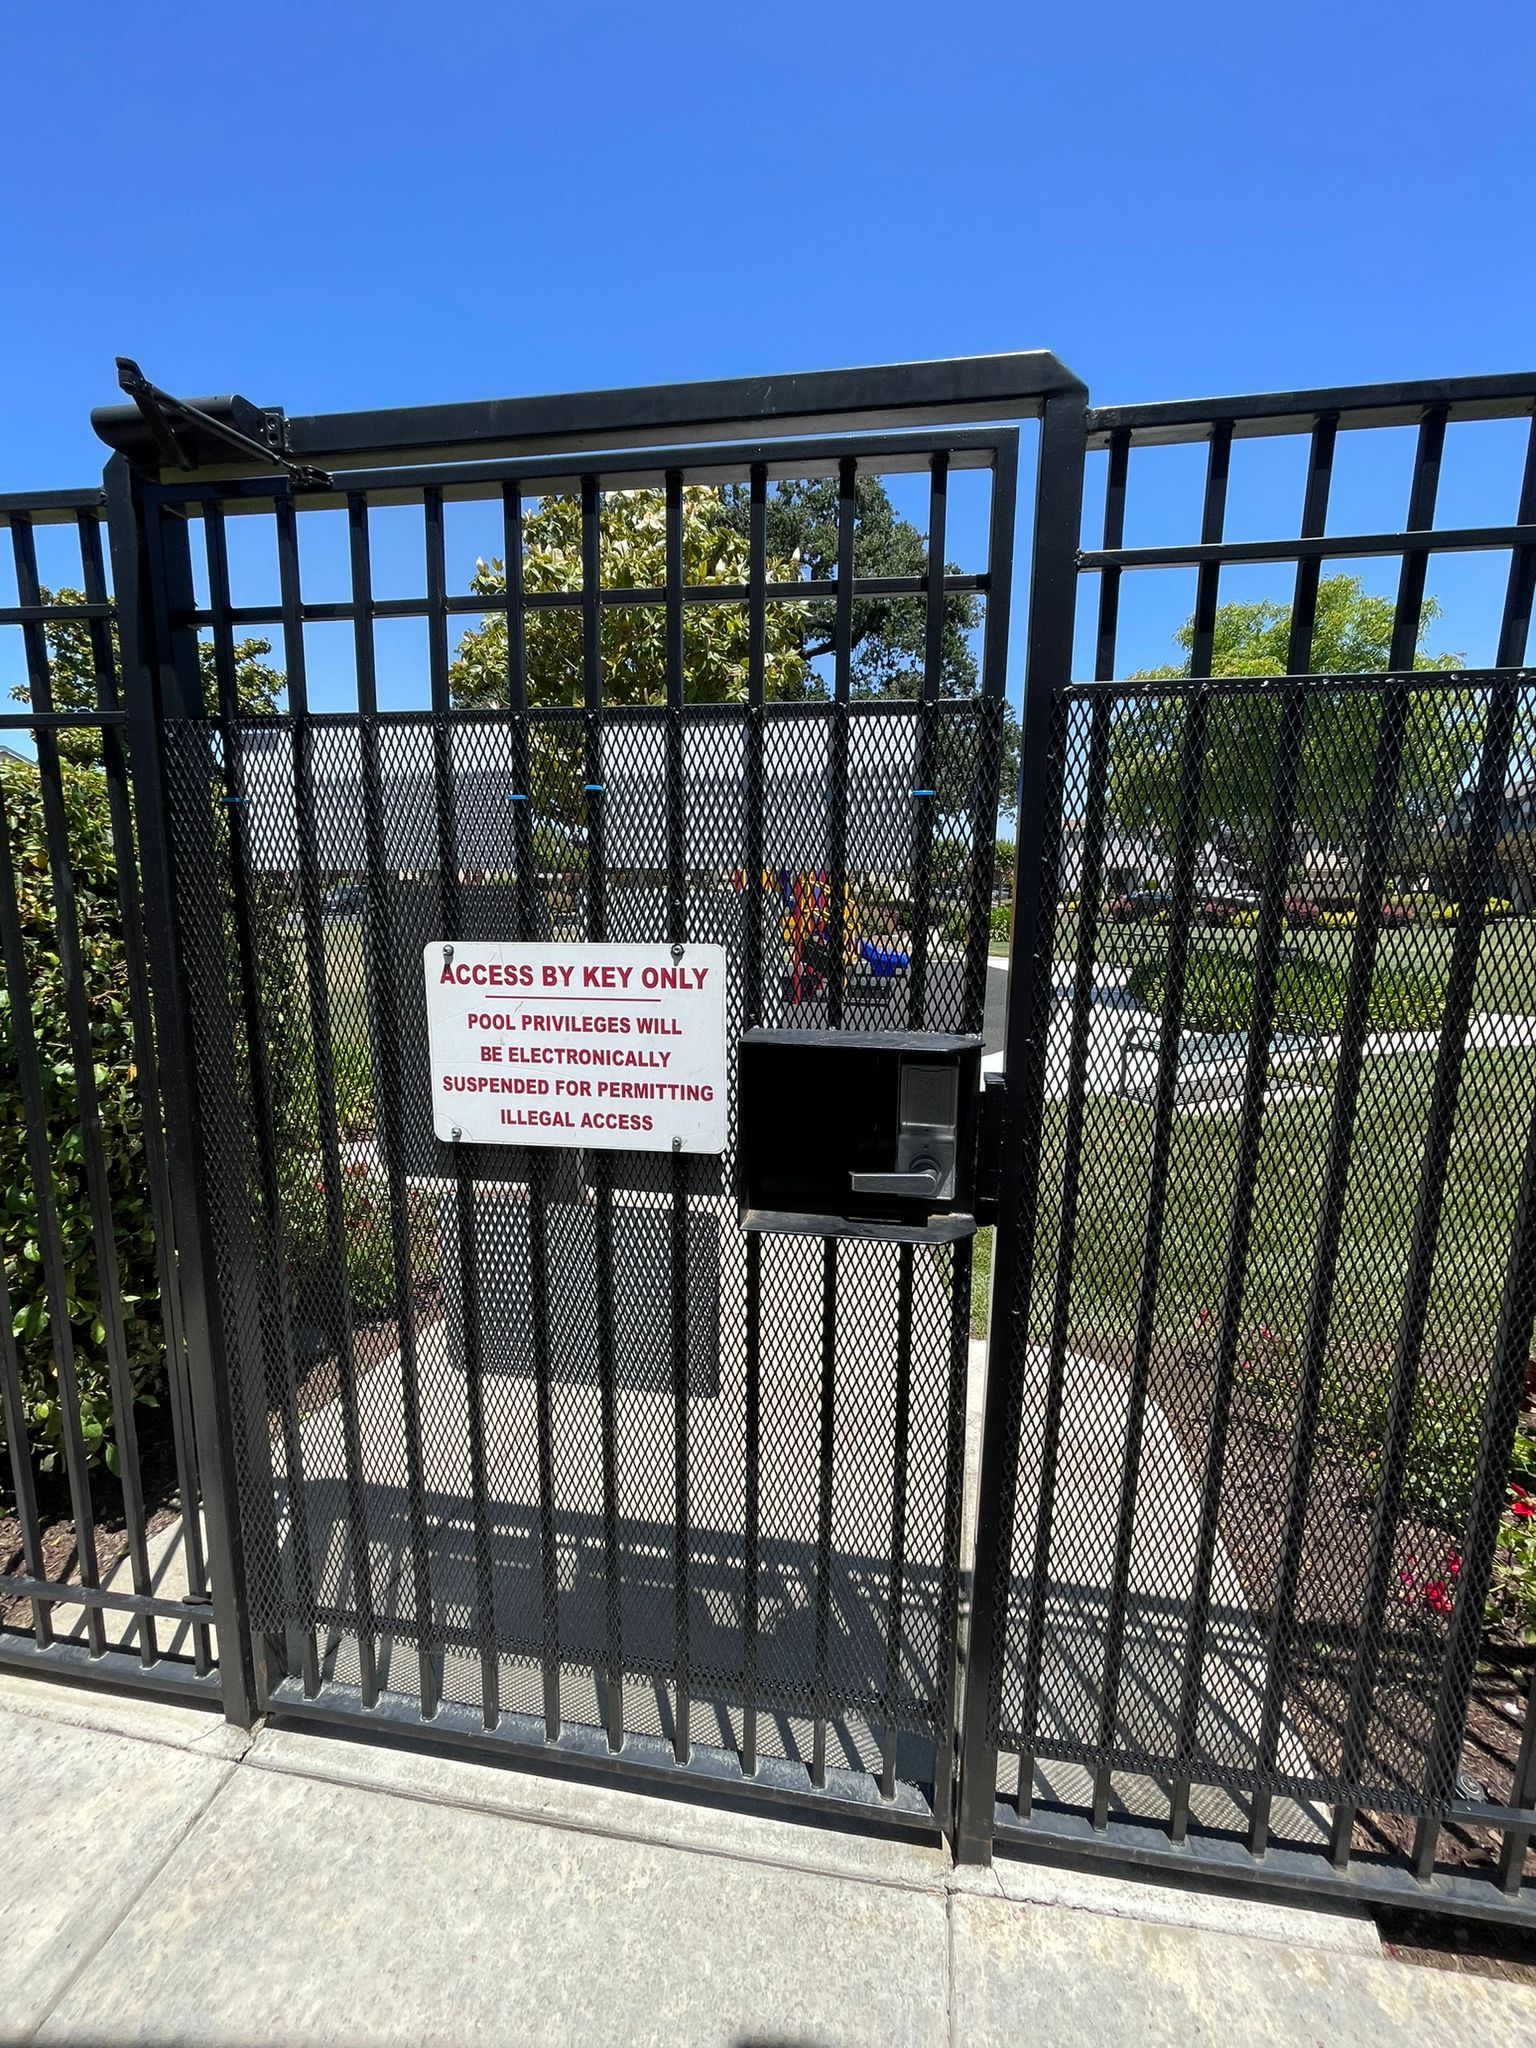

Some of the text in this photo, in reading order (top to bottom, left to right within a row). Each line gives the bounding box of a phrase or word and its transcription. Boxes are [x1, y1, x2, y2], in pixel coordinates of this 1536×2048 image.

[440, 964, 708, 990] ACCESS BY KEY ONLY
[468, 1014, 682, 1035] POOL PRIVILEGES WILL
[481, 1046, 671, 1068] BE ELECTRONICALLY
[443, 1076, 714, 1102] SUSPENDED FOR PERMITTING
[501, 1109, 653, 1131] ILLEGAL ACCESS
